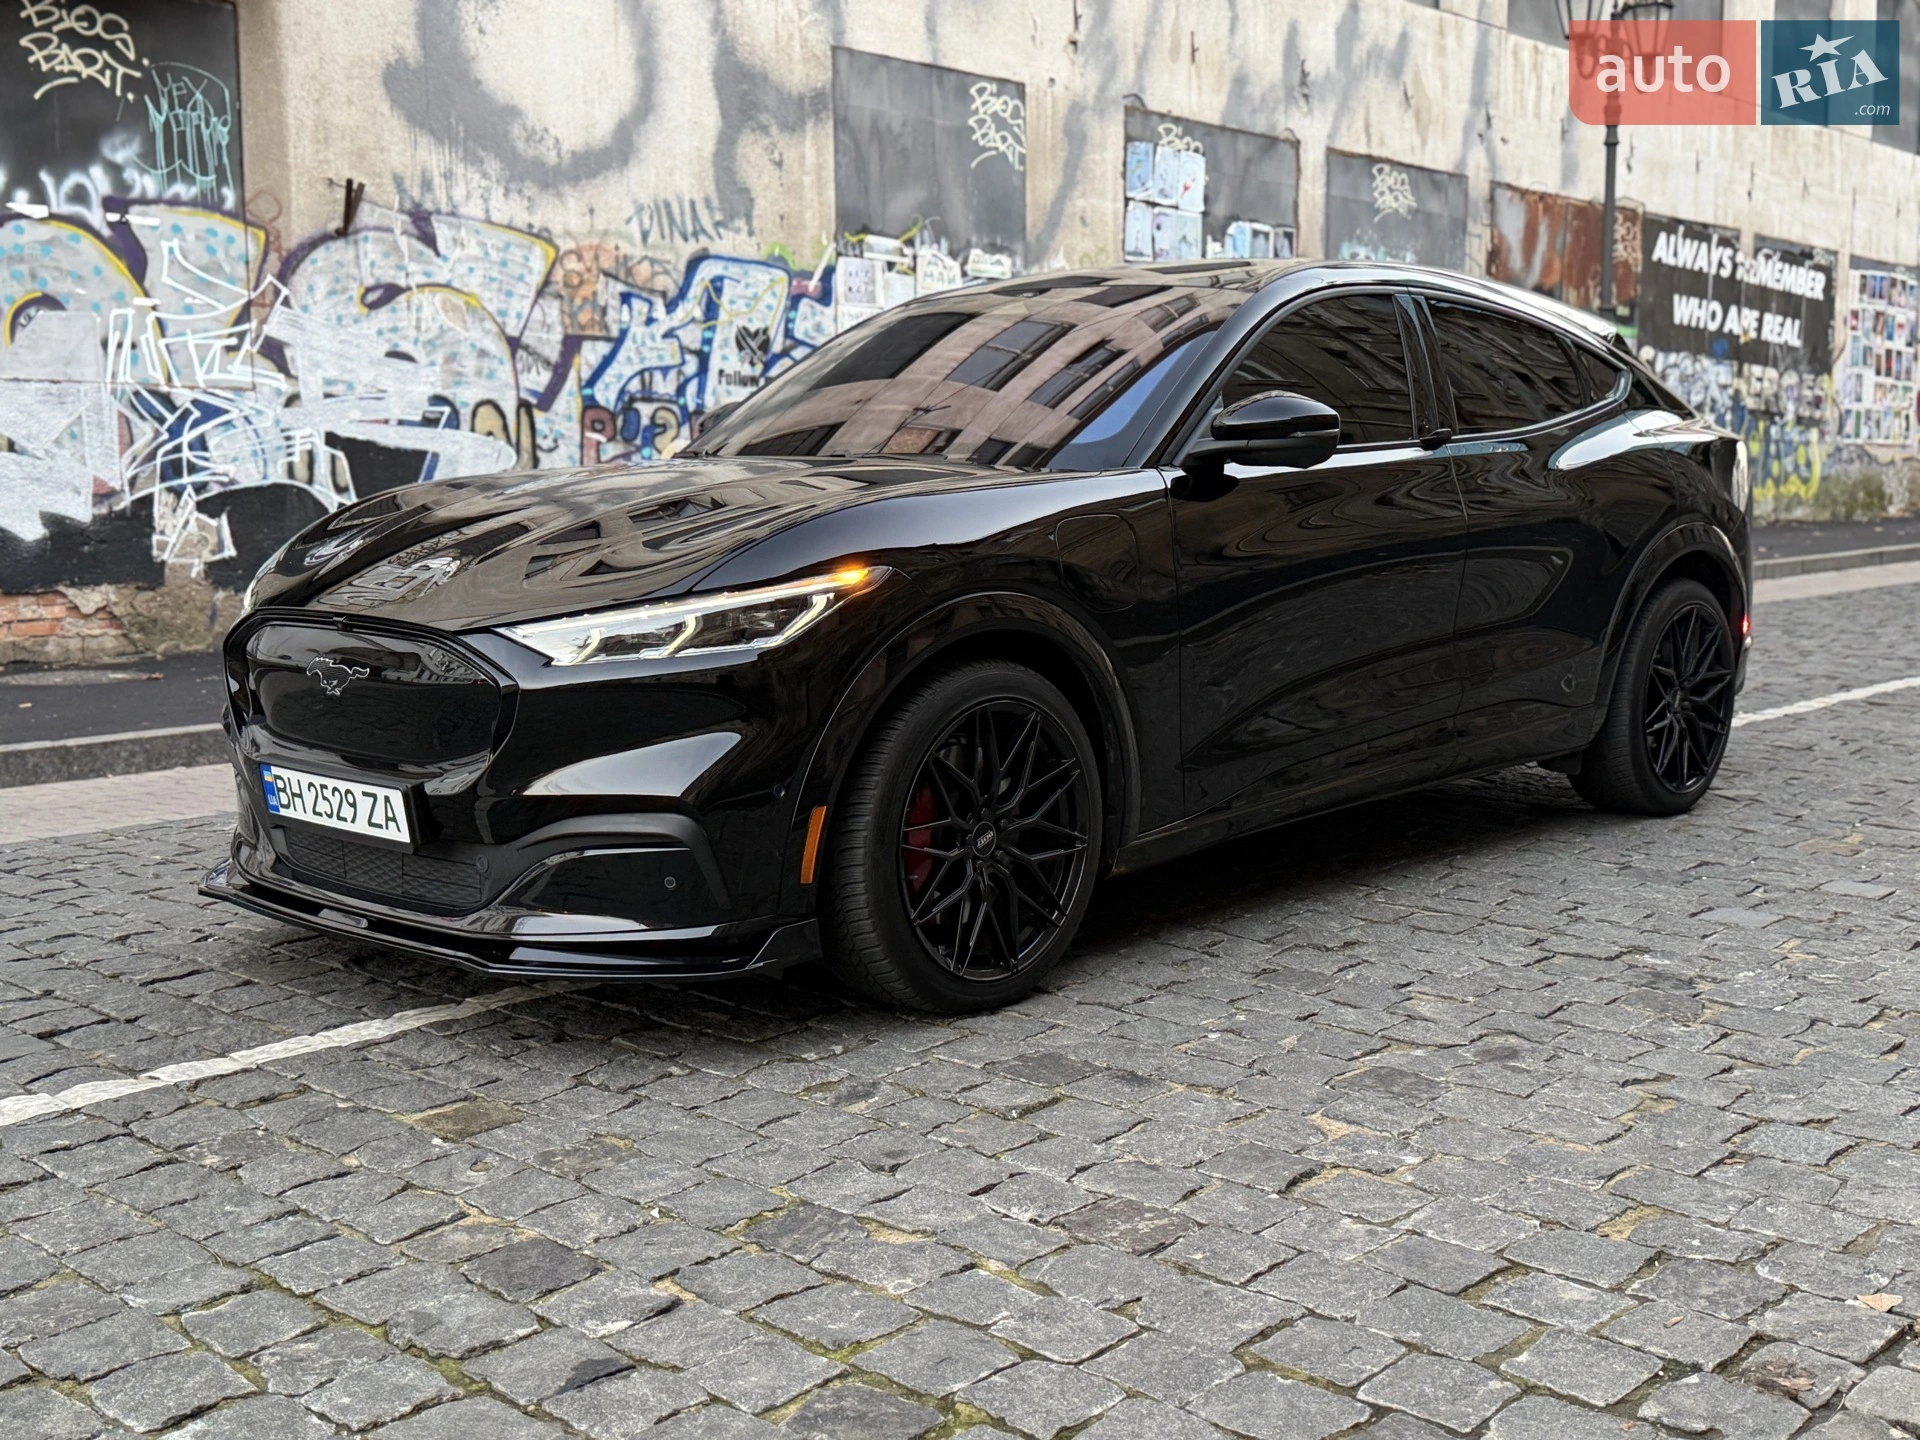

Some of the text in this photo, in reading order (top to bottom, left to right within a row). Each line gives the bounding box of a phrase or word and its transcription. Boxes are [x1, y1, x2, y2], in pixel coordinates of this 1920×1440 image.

[1651, 227, 1735, 279] ALWAYS
[1735, 250, 1827, 301] REMEMBER
[1672, 293, 1802, 348] WHO ARE REAL
[267, 794, 279, 806] UA
[273, 773, 402, 833] BH 2529 ZA
